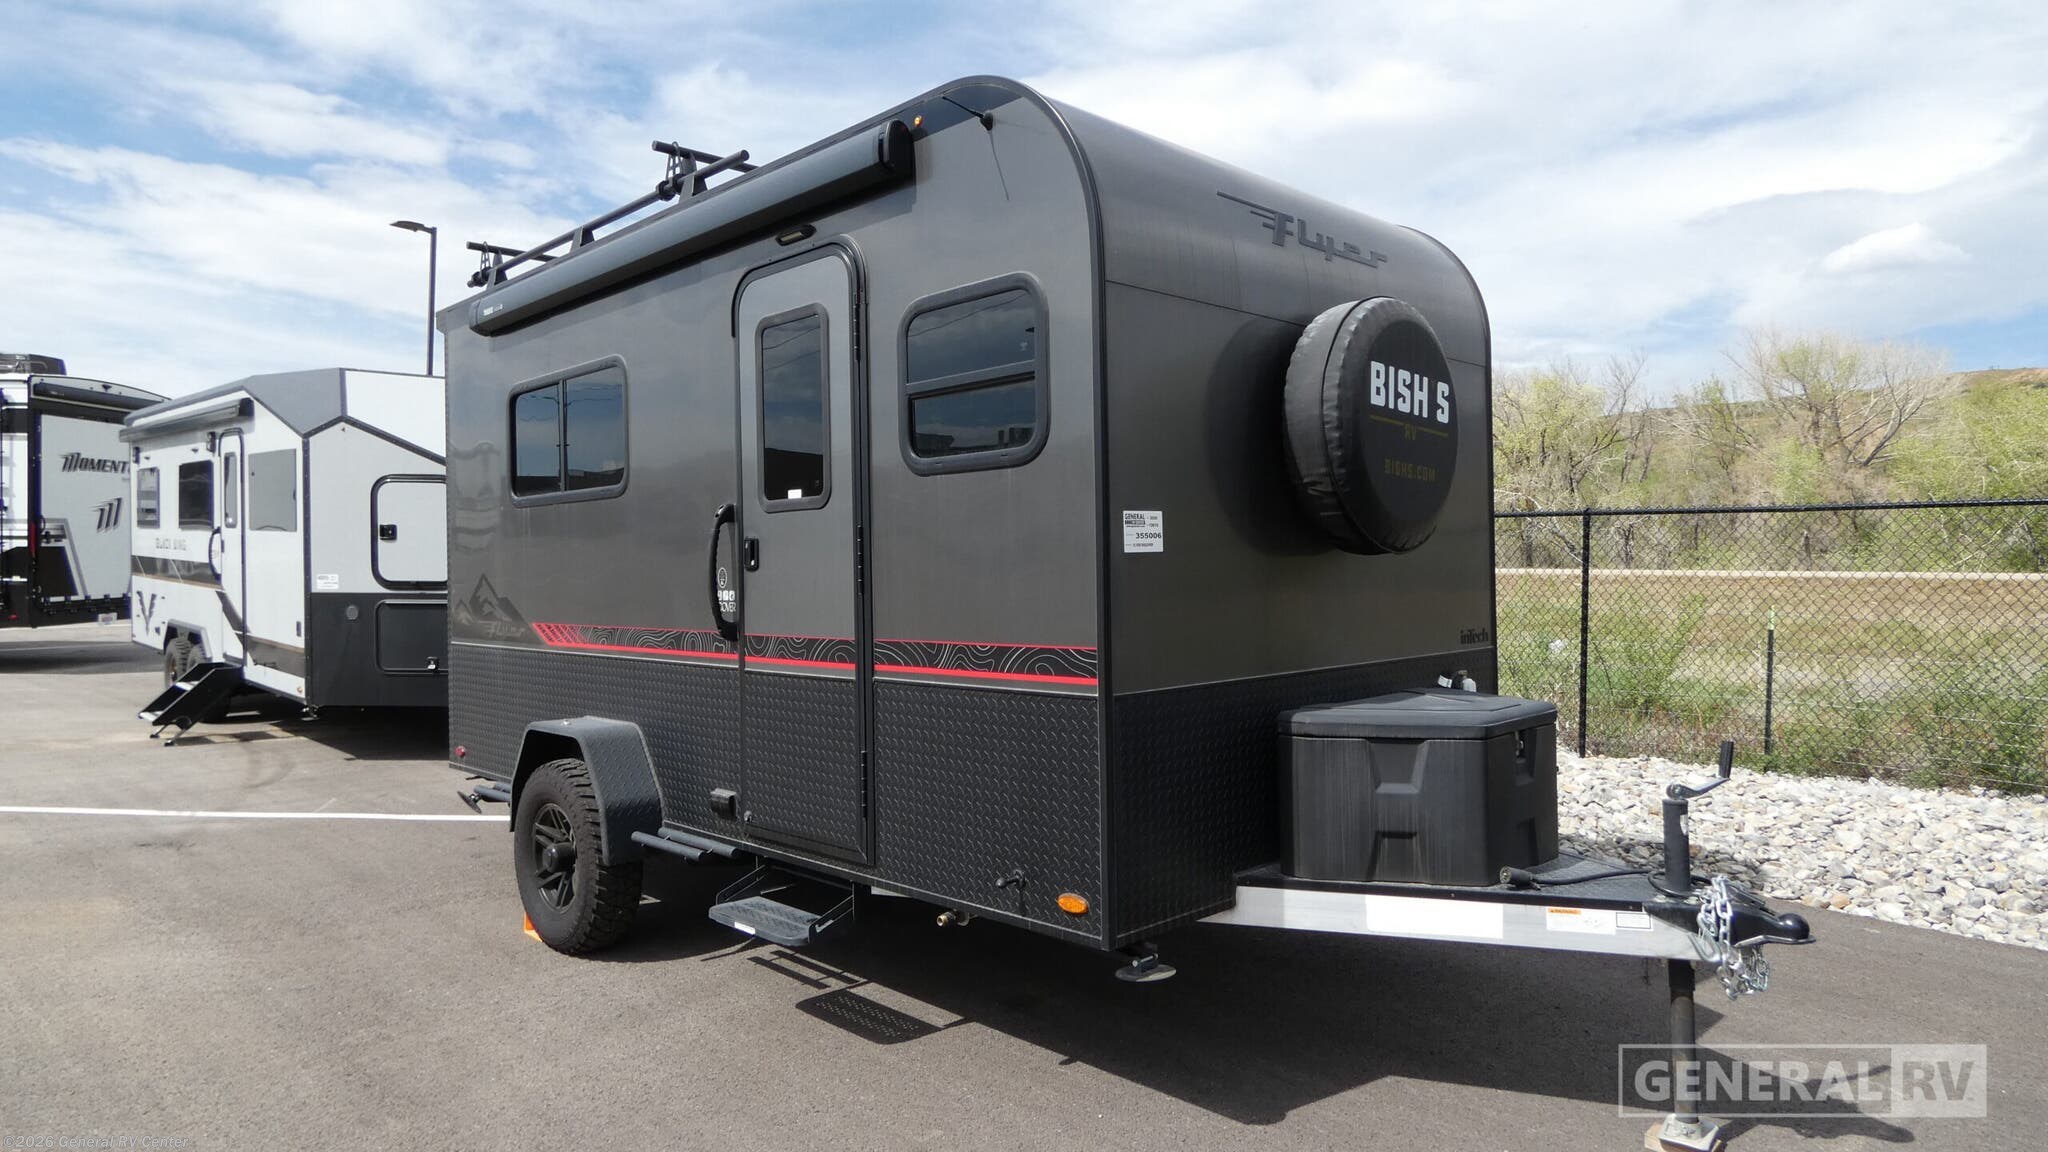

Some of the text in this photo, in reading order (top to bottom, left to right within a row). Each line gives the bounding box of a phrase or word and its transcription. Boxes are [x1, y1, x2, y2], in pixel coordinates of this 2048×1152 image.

[59, 451, 131, 474] MOMENT
[1135, 532, 1162, 540] 355006
[1460, 628, 1489, 645] inTech
